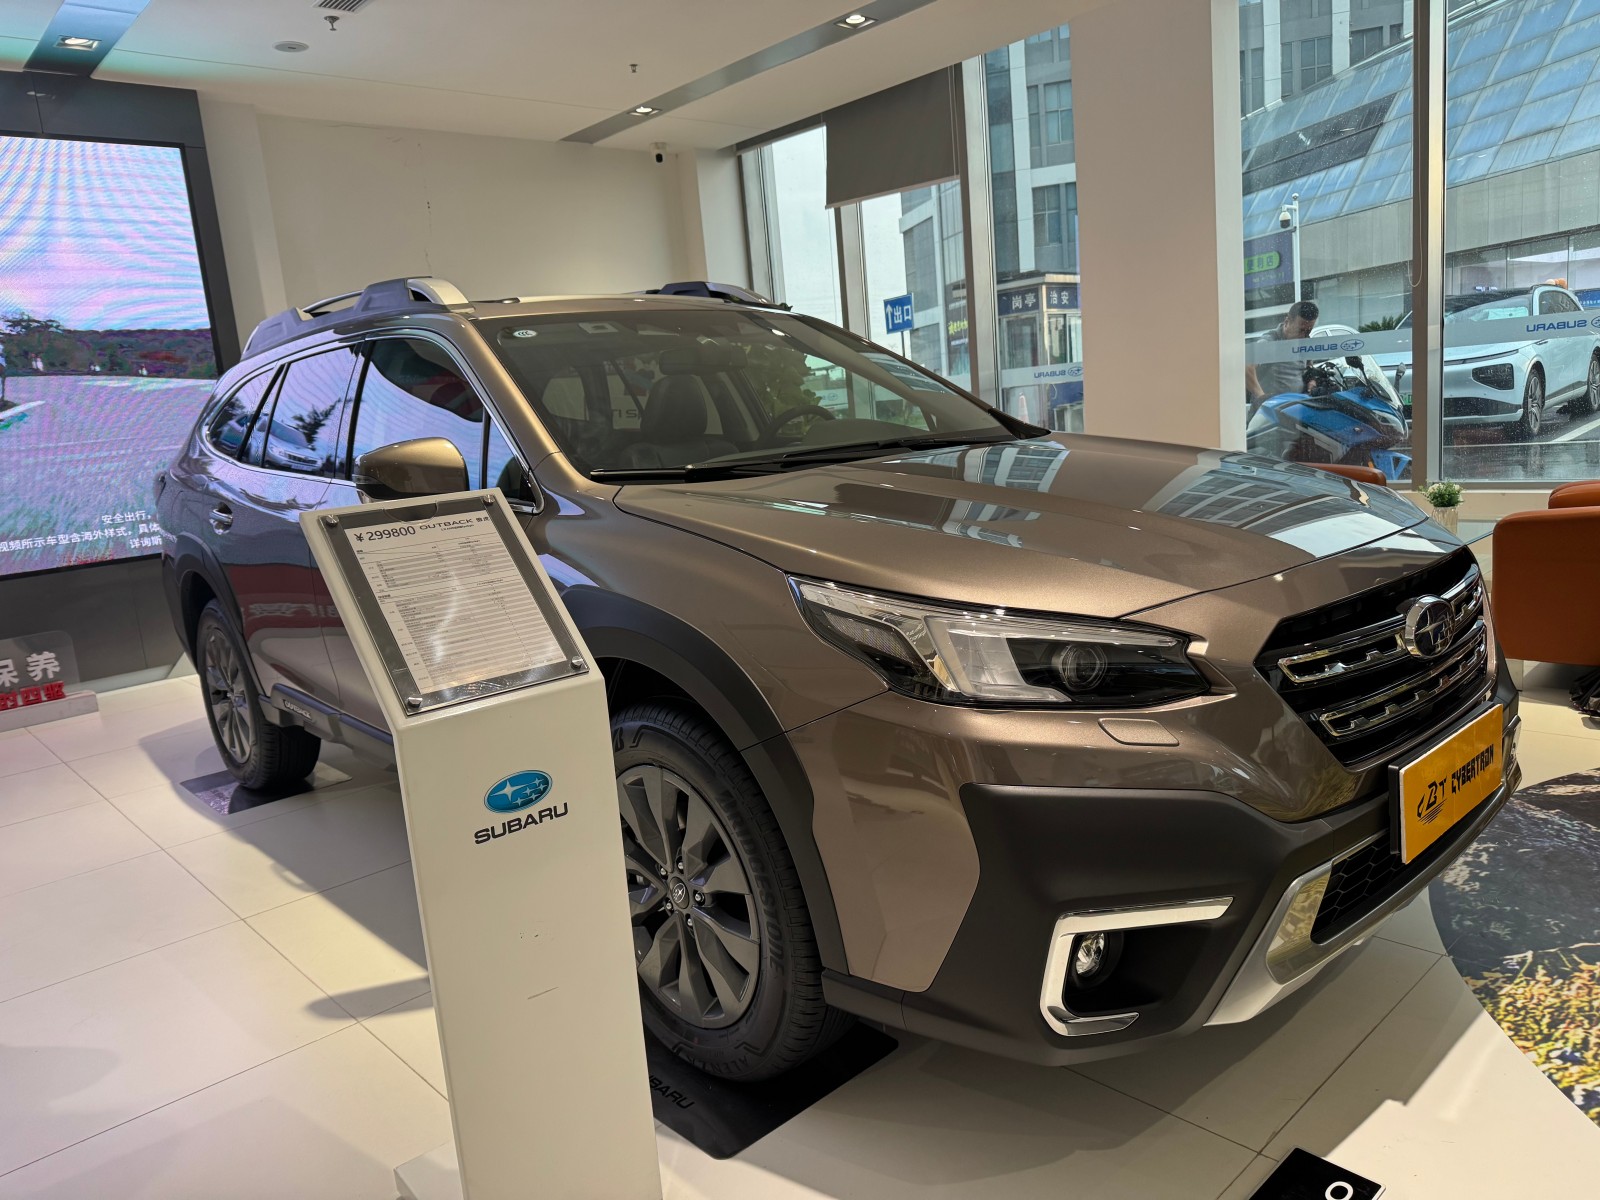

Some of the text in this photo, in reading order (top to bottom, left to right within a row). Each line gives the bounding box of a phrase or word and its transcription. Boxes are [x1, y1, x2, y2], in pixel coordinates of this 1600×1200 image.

[1012, 292, 1036, 310] 岗亭
[1050, 289, 1069, 305] 治安
[893, 305, 912, 324] 出口
[419, 518, 473, 530] OUTBACK
[1451, 743, 1494, 794] CYBERTRON
[474, 802, 568, 844] SUBARU
[649, 1075, 695, 1109] BARU
